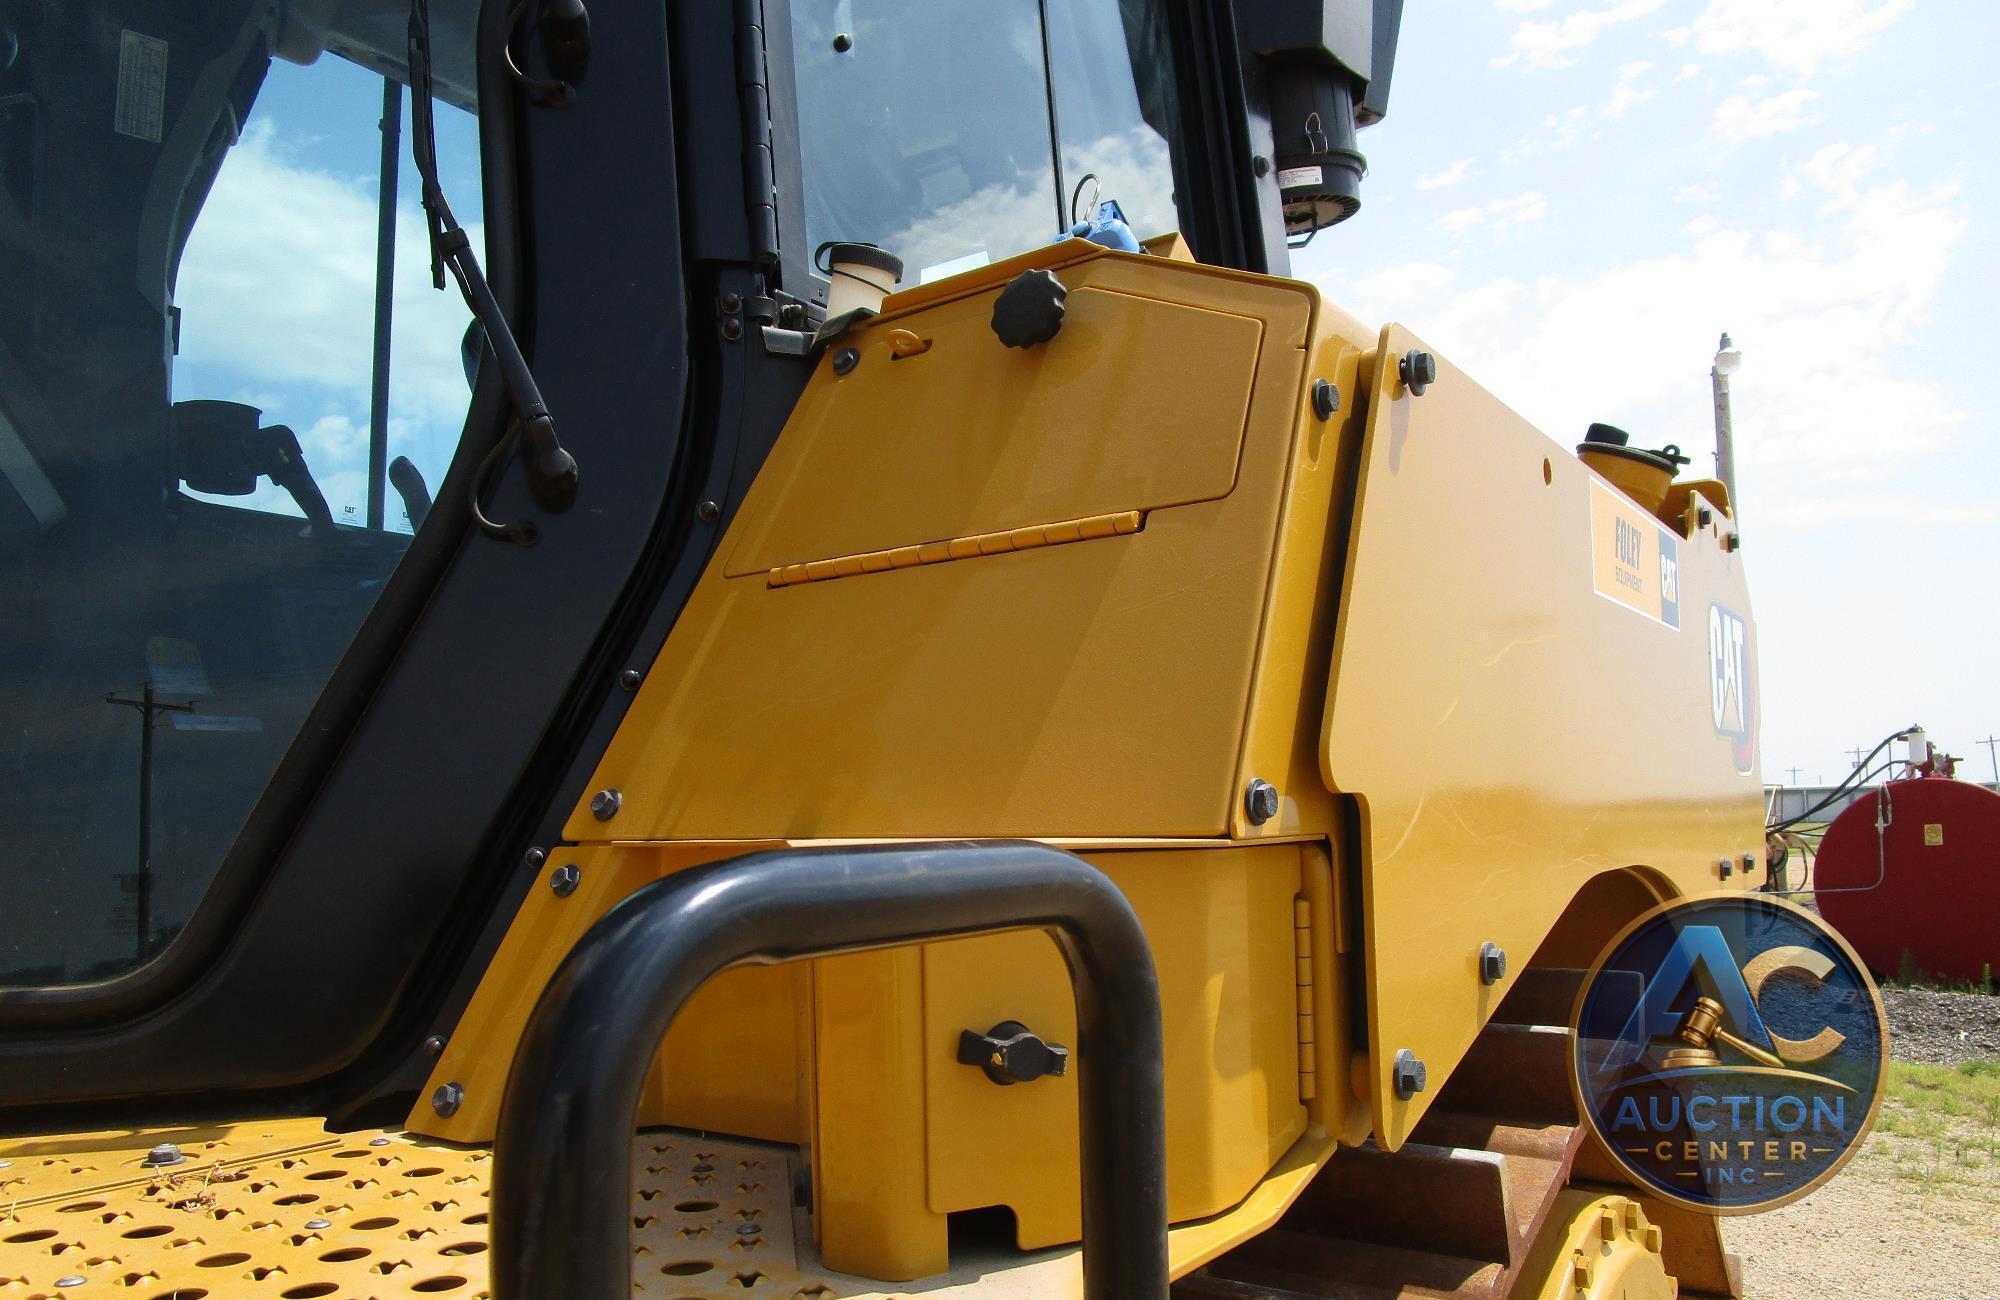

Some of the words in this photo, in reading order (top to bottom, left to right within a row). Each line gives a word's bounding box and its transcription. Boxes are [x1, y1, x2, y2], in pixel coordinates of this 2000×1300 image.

[1615, 516, 1641, 570] FOLEY
[1615, 565, 1642, 592] EQUIPMENT
[1661, 554, 1677, 604] CAT
[1710, 603, 1745, 733] CAT
